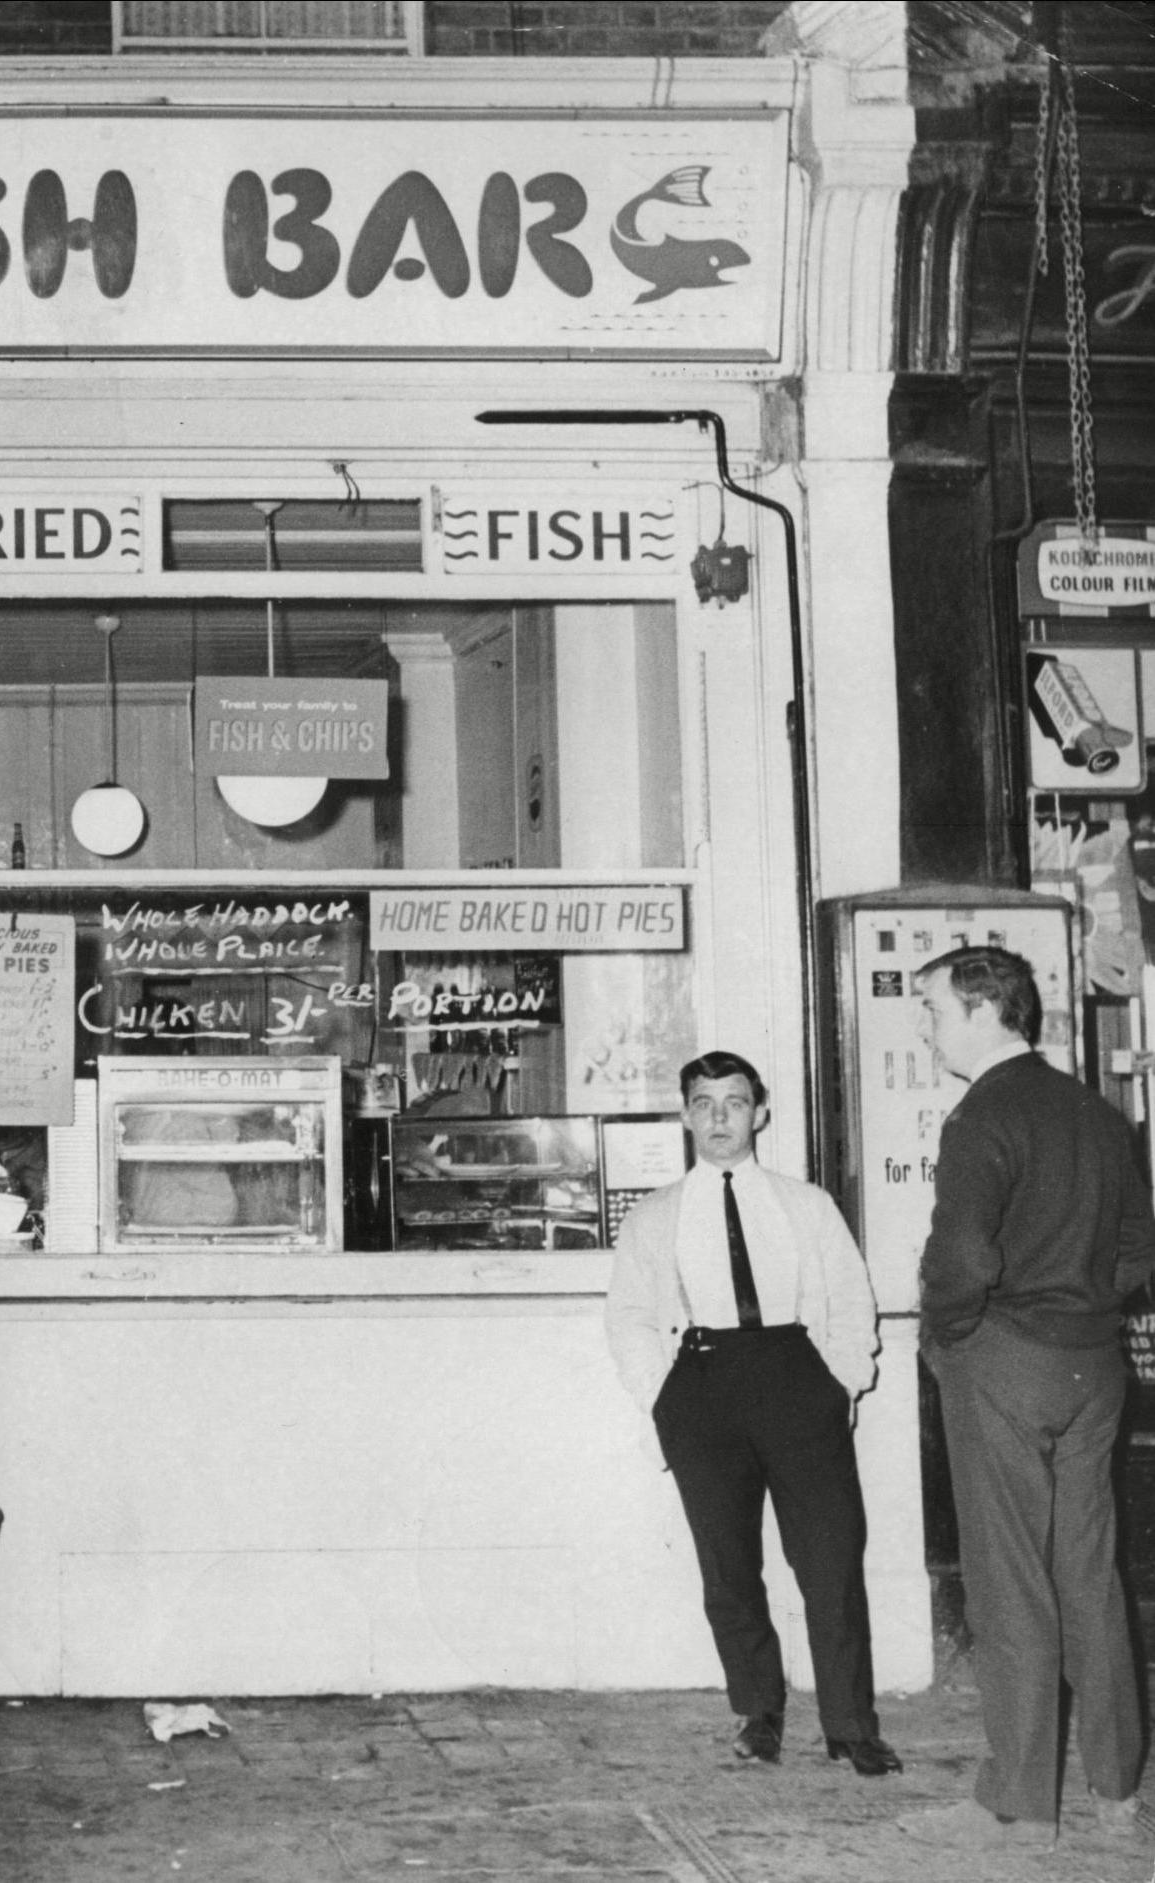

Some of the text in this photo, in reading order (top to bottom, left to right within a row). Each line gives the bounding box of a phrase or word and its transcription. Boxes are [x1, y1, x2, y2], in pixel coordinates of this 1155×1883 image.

[223, 167, 594, 299] BAR
[488, 510, 630, 561] FISH
[1050, 575, 1114, 592] COLOUR
[220, 700, 358, 712] Treat your family to
[209, 720, 375, 752] FISH & CHIPS
[102, 901, 206, 932] WHOLE
[379, 900, 675, 932] HOME BAKED HOT PIES
[12, 942, 58, 954] BAKED
[4, 957, 51, 973] PIES
[327, 983, 375, 1000] PER
[388, 981, 544, 1020] PORTION
[885, 1157, 911, 1183] for
